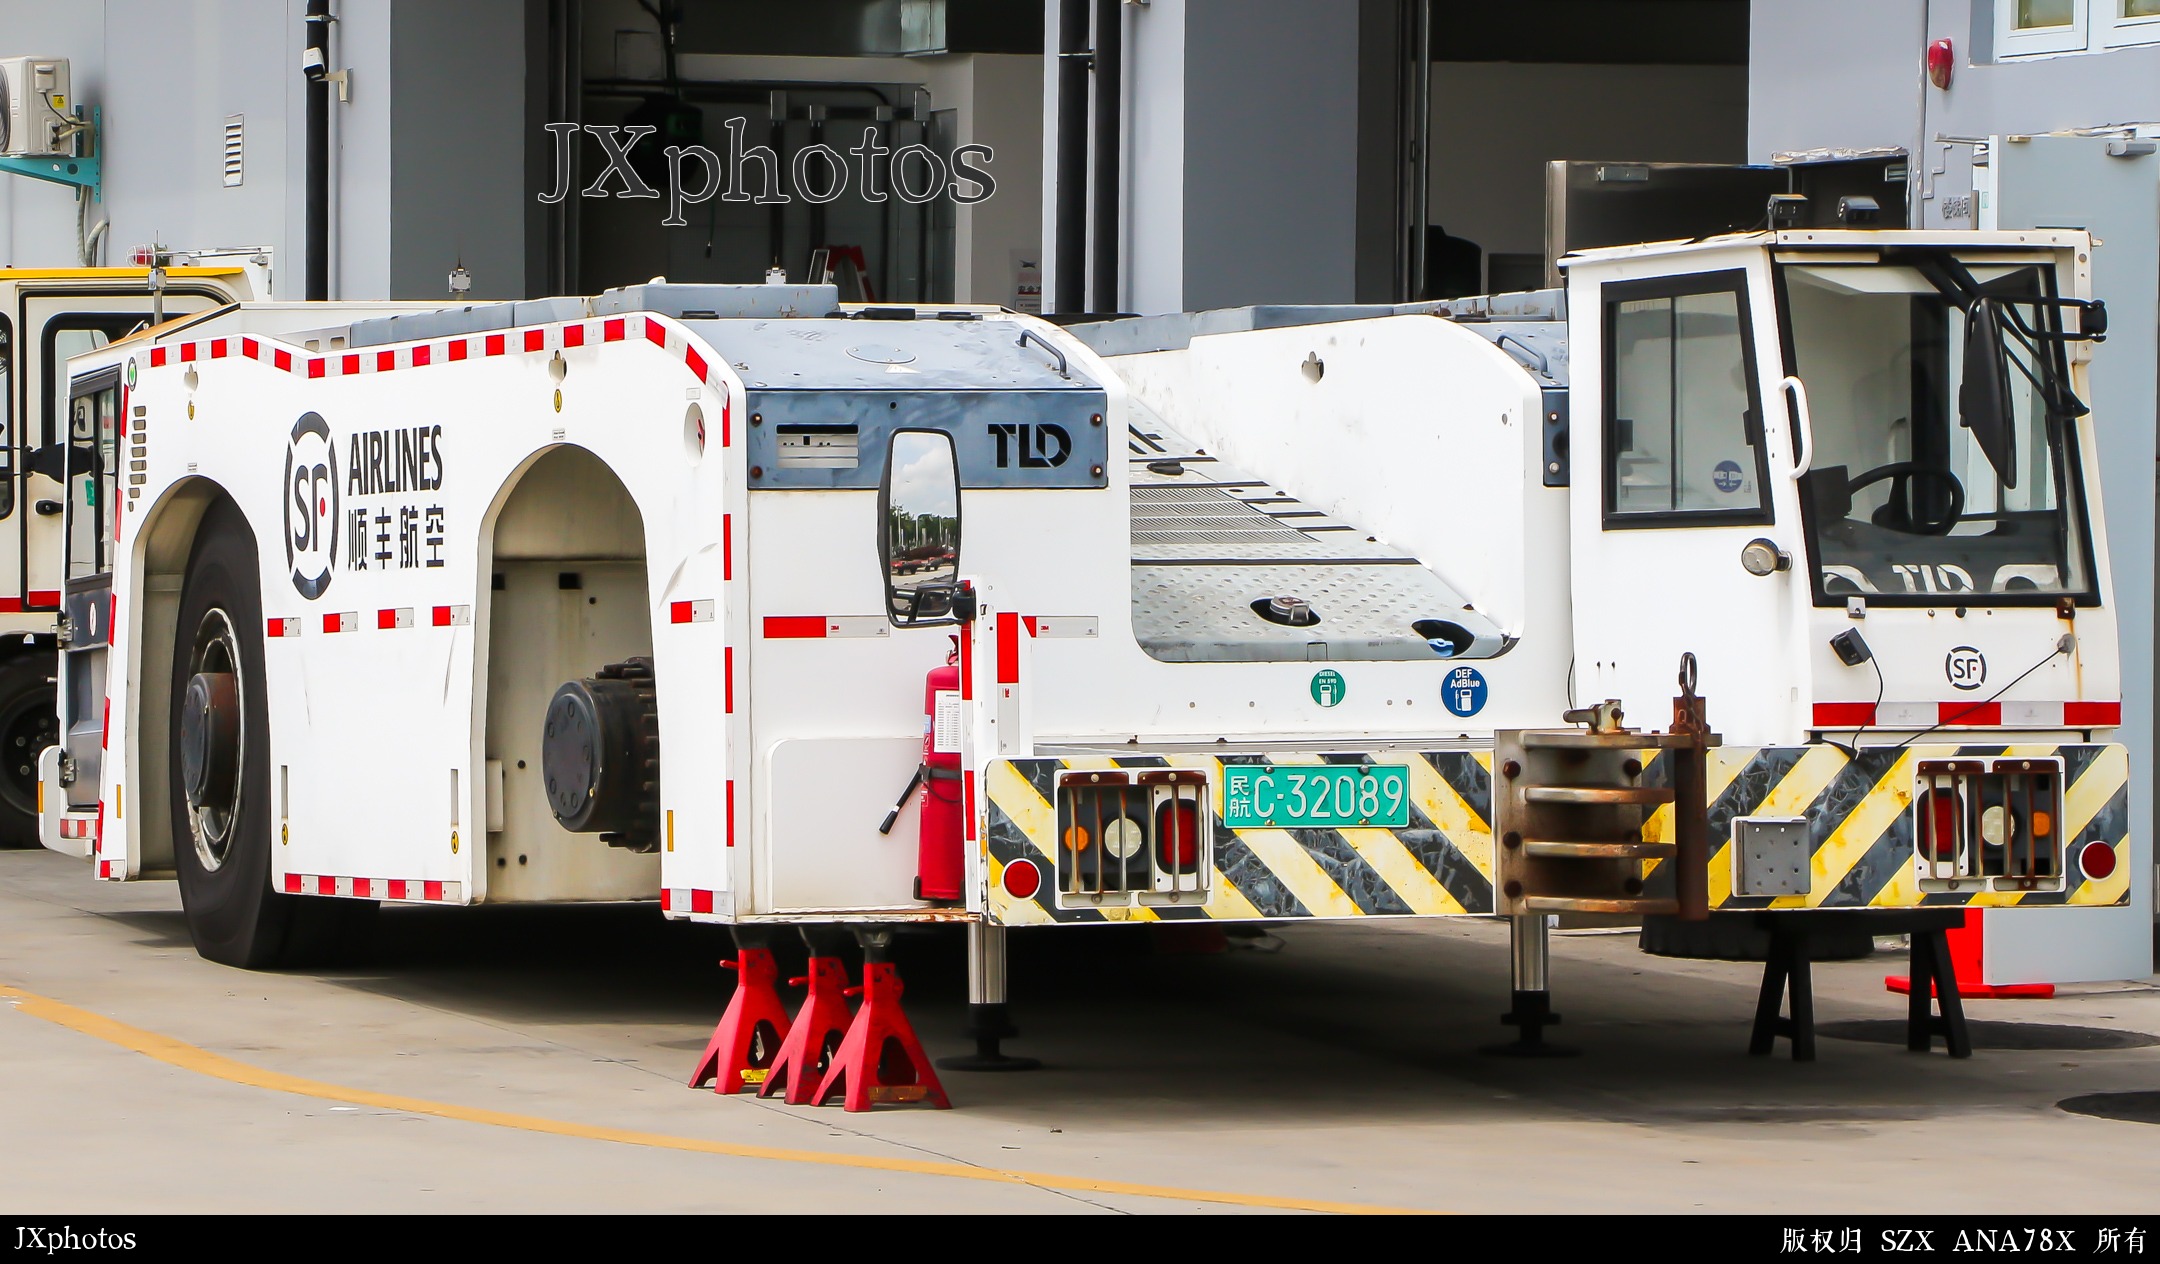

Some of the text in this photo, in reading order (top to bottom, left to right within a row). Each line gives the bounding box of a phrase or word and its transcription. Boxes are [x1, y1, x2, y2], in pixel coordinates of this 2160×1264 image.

[348, 424, 443, 496] AIRLINES
[987, 423, 1072, 468] TLD
[294, 463, 329, 552] SF
[348, 504, 445, 572] 顺丰航空
[1450, 679, 1481, 689] AdBlue
[1455, 669, 1472, 679] DEF
[1953, 657, 1979, 680] SF
[1229, 775, 1251, 818] 民航
[1254, 775, 1404, 818] C-32089
